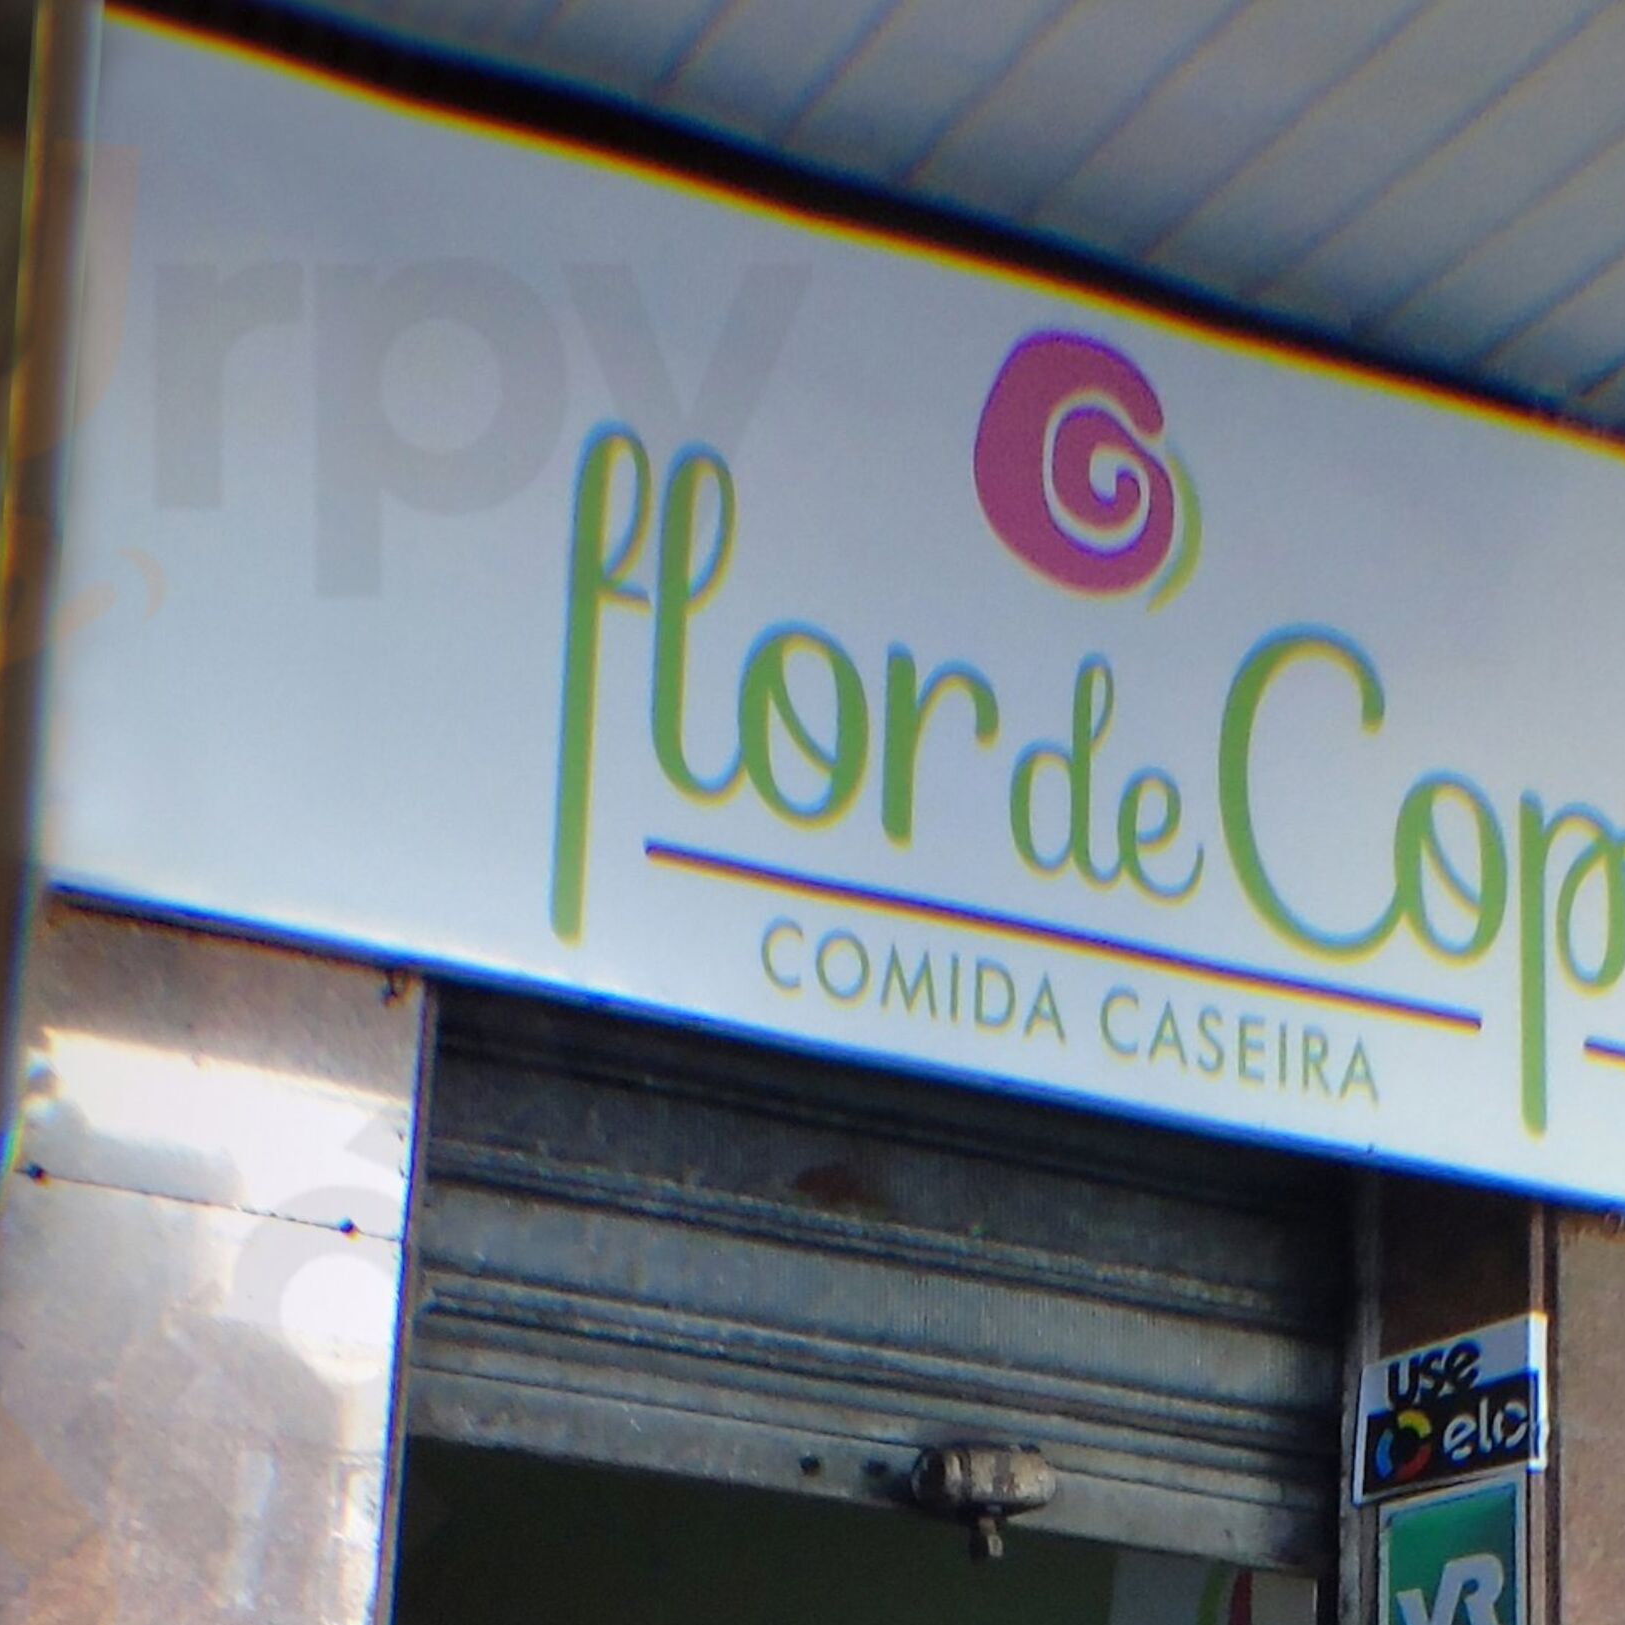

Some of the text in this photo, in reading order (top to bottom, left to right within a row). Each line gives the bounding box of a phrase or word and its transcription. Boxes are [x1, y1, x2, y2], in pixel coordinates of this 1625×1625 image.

[548, 420, 1000, 945] flor
[1006, 650, 1206, 902] de
[758, 915, 1382, 1106] COMIDA CASEIRA
[1387, 1341, 1481, 1405] use
